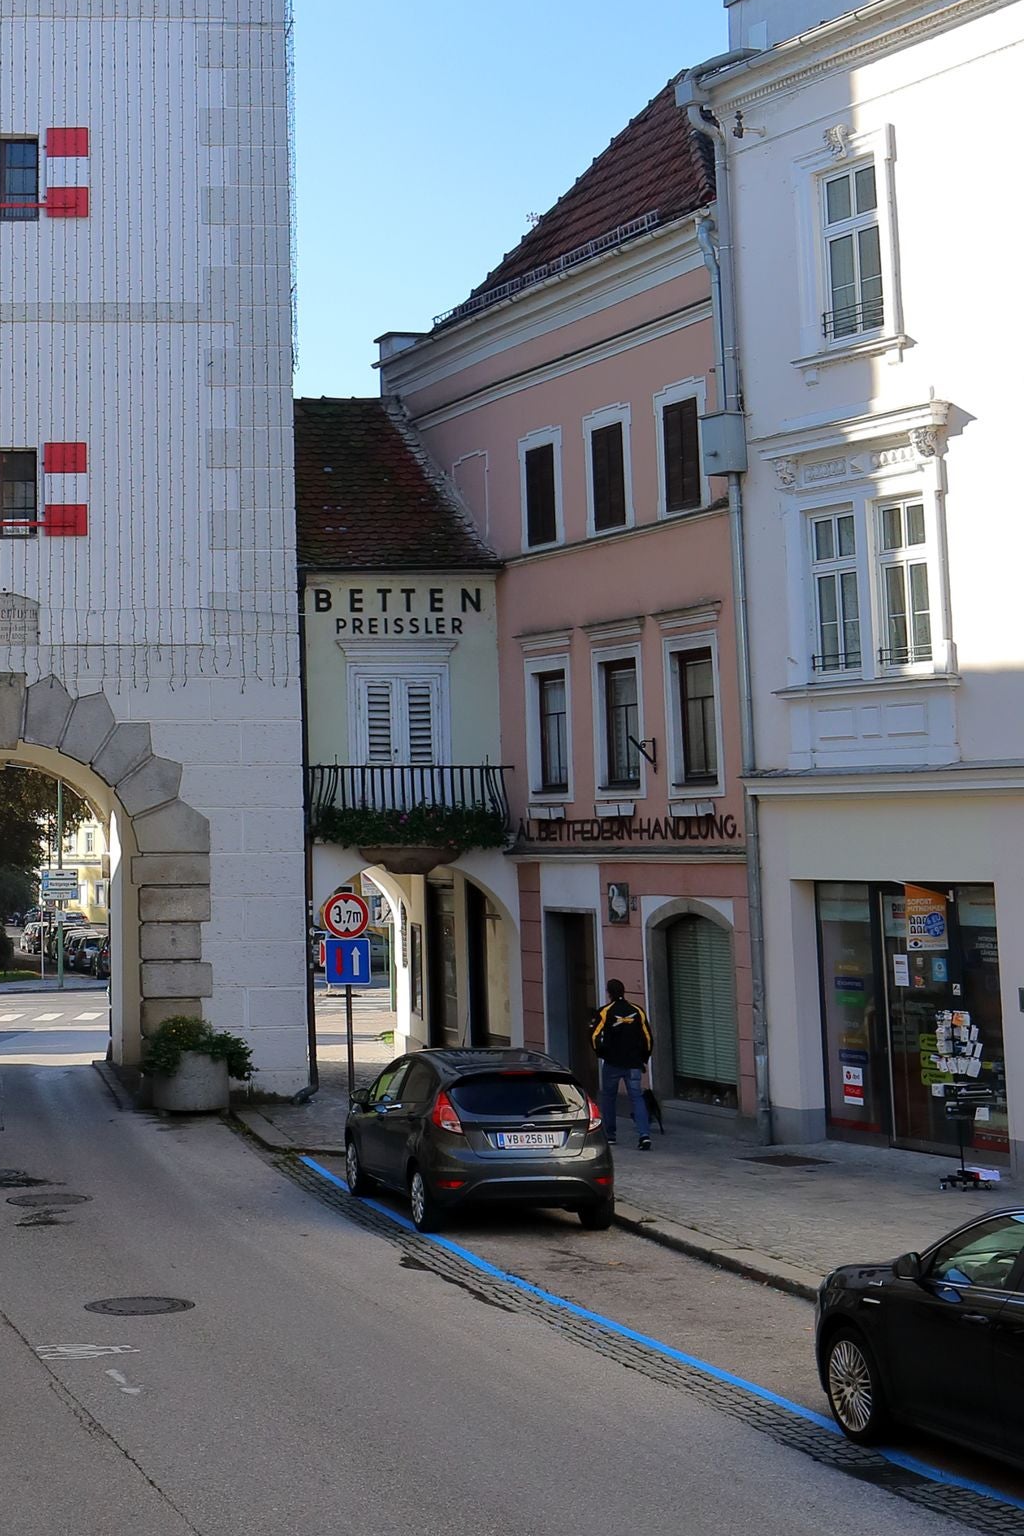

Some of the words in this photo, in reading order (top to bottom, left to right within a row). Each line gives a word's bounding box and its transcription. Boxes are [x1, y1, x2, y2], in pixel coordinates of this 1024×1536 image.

[314, 588, 481, 613] BETTEN
[336, 617, 463, 634] PREISSLER
[507, 1134, 519, 1144] VB
[525, 1134, 543, 1144] 256
